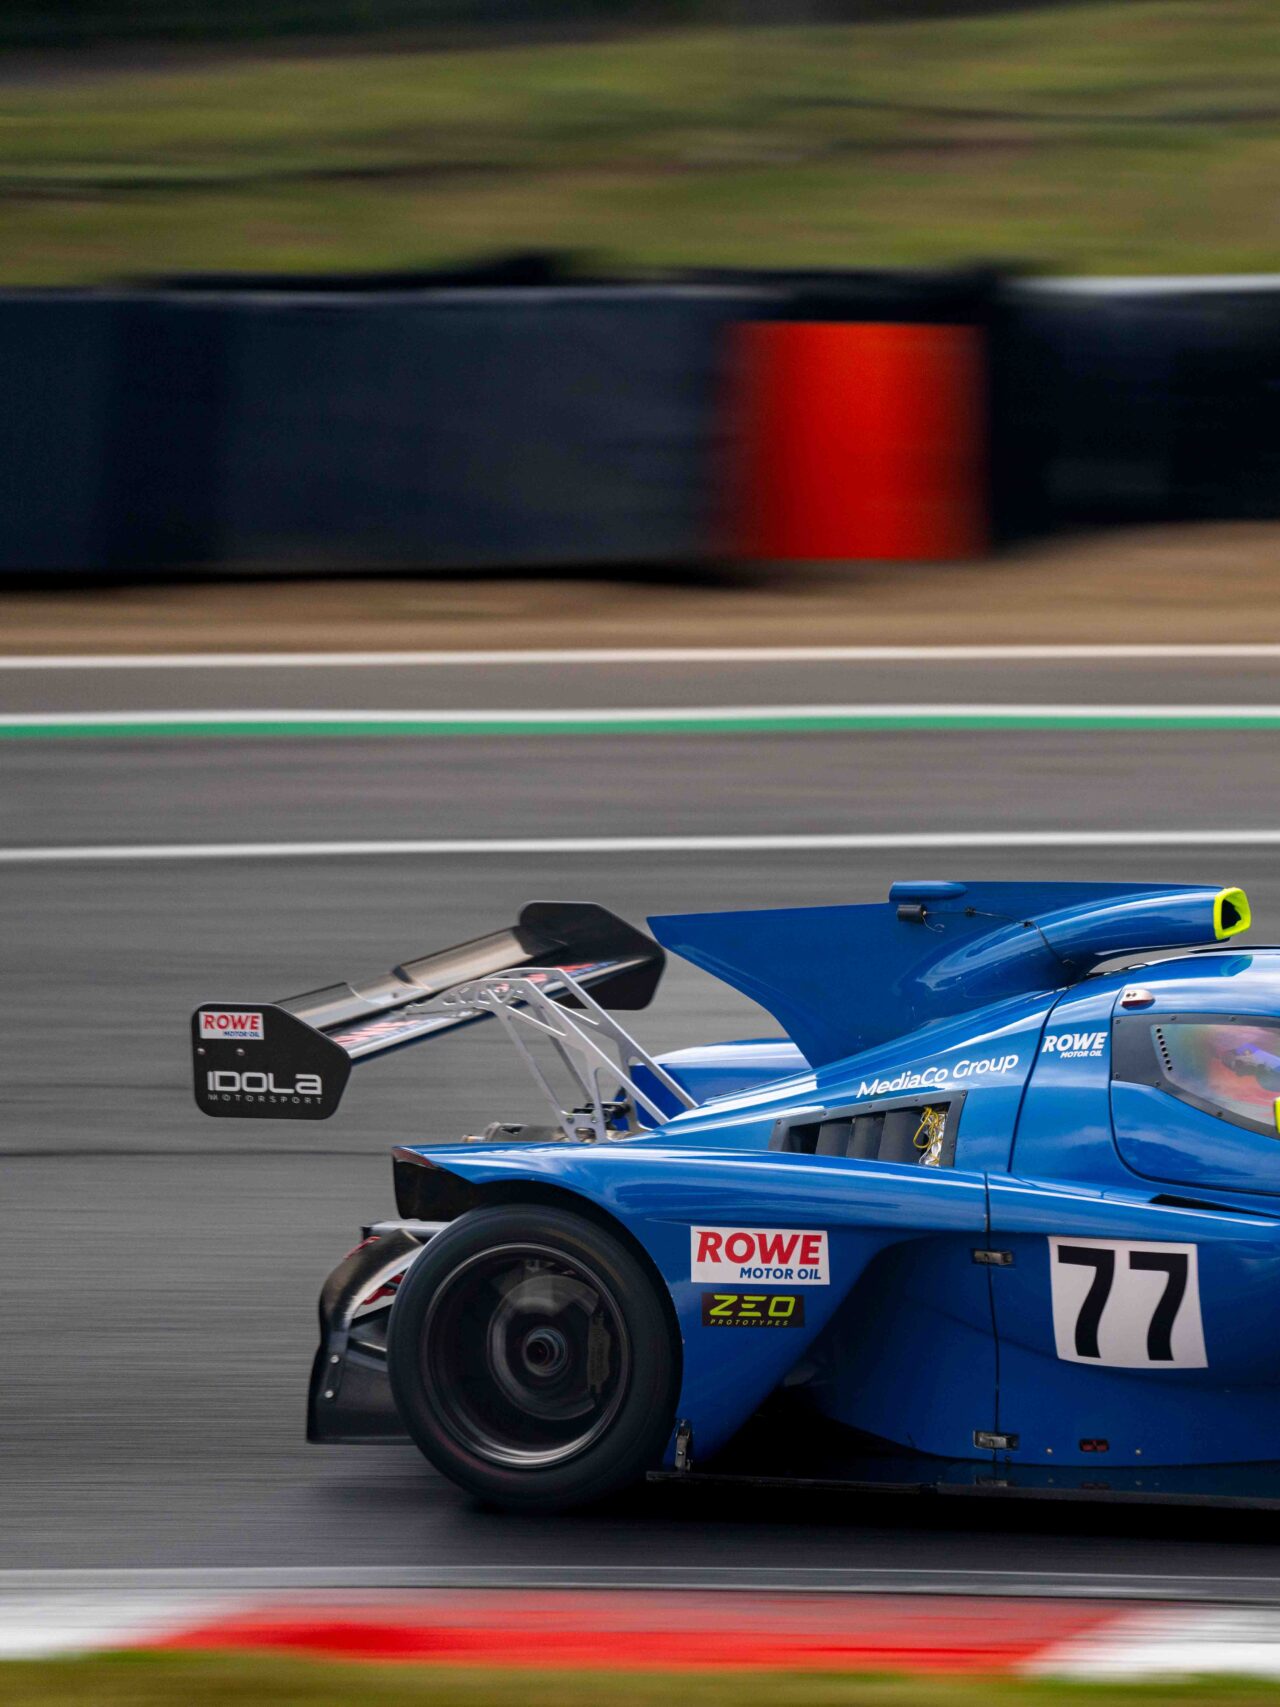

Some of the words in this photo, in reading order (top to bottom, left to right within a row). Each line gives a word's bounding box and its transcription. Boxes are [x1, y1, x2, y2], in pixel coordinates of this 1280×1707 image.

[203, 1014, 261, 1030] ROWE
[1041, 1031, 1108, 1053] ROWE
[1060, 1050, 1088, 1059] MOTOR
[1089, 1049, 1103, 1057] OIL
[856, 1066, 948, 1098] MediaCo
[951, 1053, 1019, 1079] Group
[207, 1093, 323, 1105] MOTORSPORT
[696, 1231, 822, 1265] ROWE
[740, 1267, 793, 1280] MOTOR
[797, 1268, 821, 1280] OIL
[1057, 1244, 1189, 1361] 77
[710, 1318, 789, 1326] PROTOTYPES
